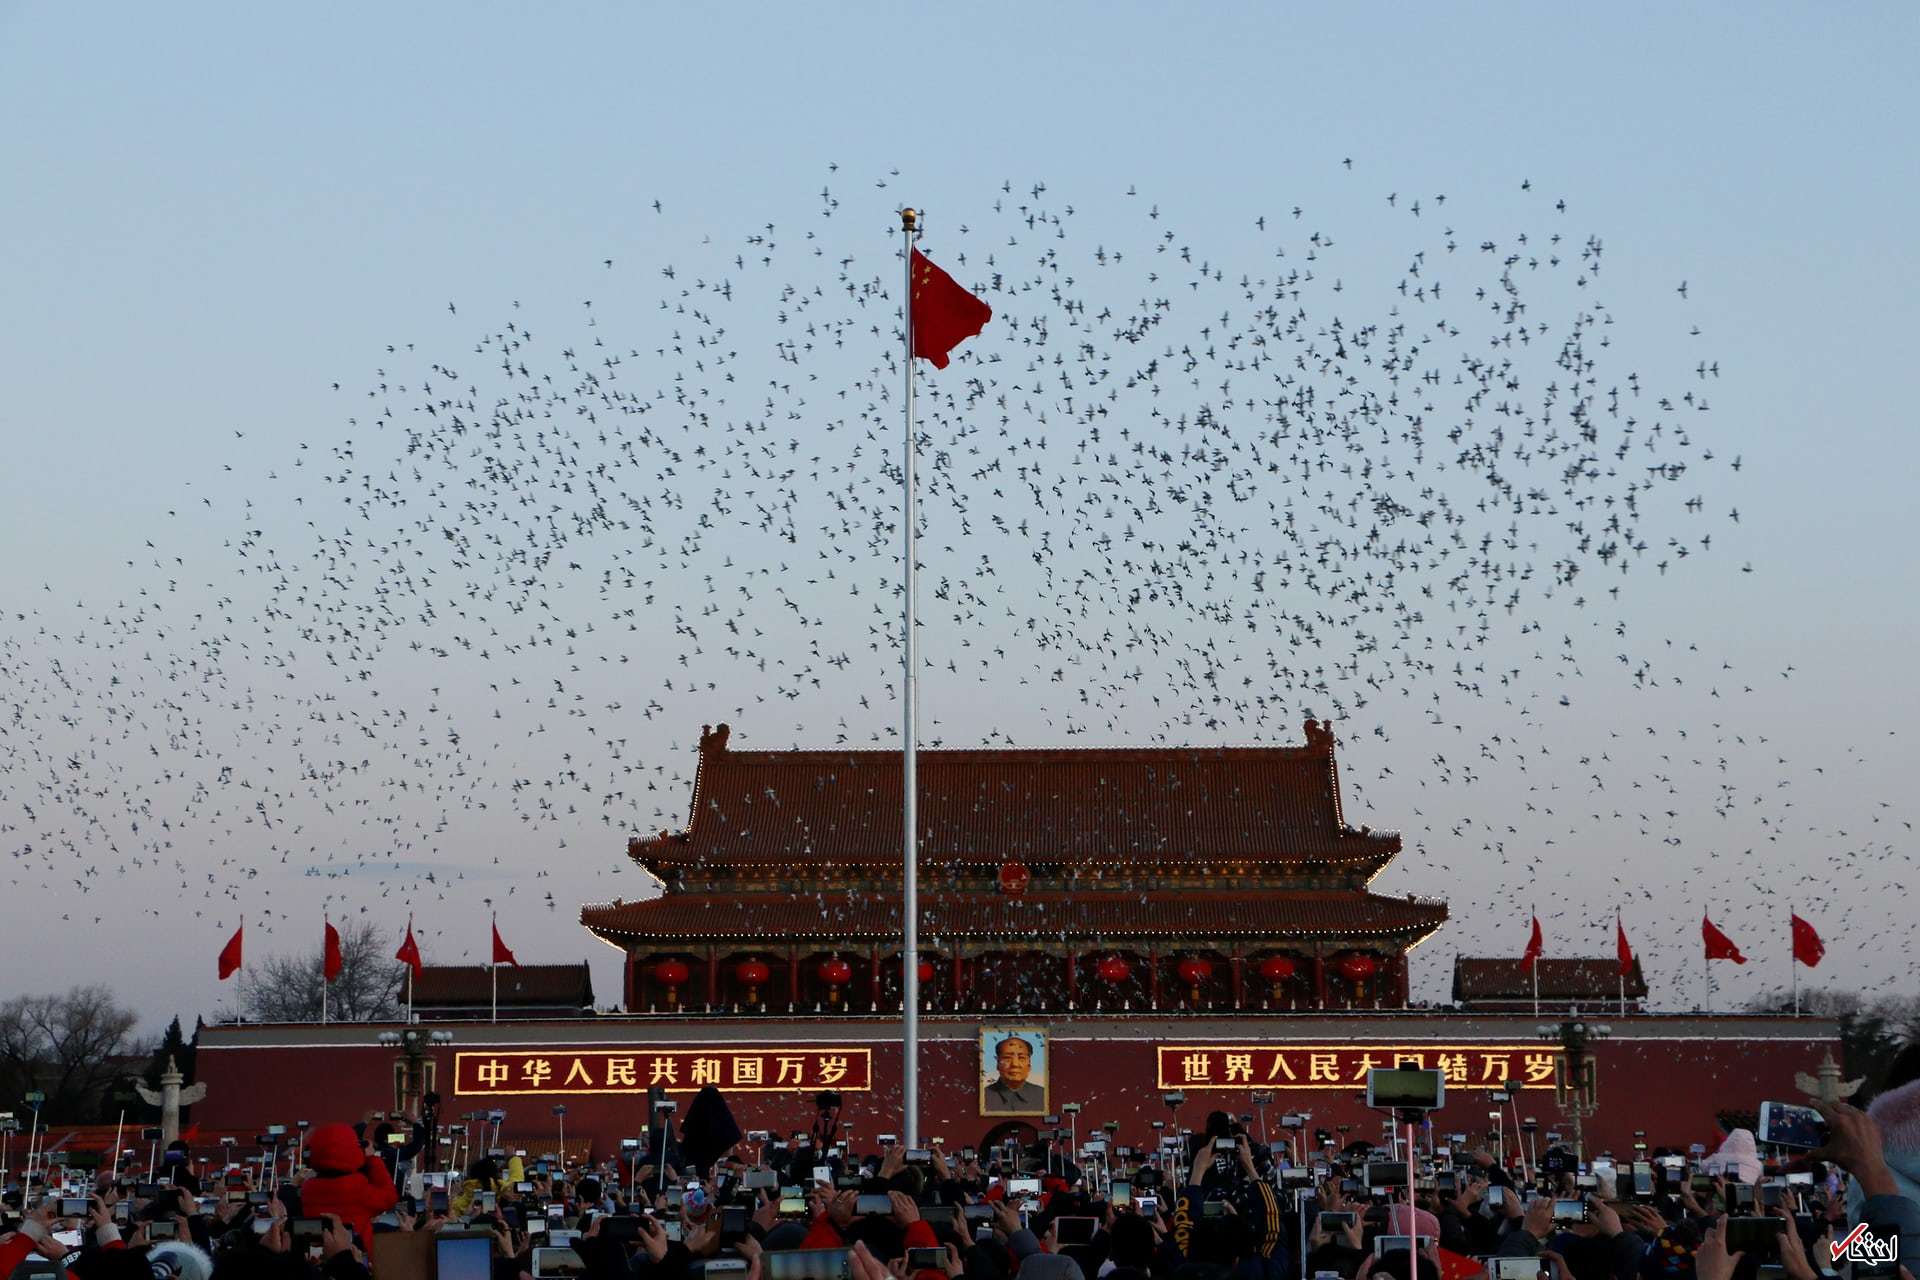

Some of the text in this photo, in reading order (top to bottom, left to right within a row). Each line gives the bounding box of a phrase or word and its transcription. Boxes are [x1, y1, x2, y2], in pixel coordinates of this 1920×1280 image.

[477, 1055, 848, 1087] 中华人民共和国万岁
